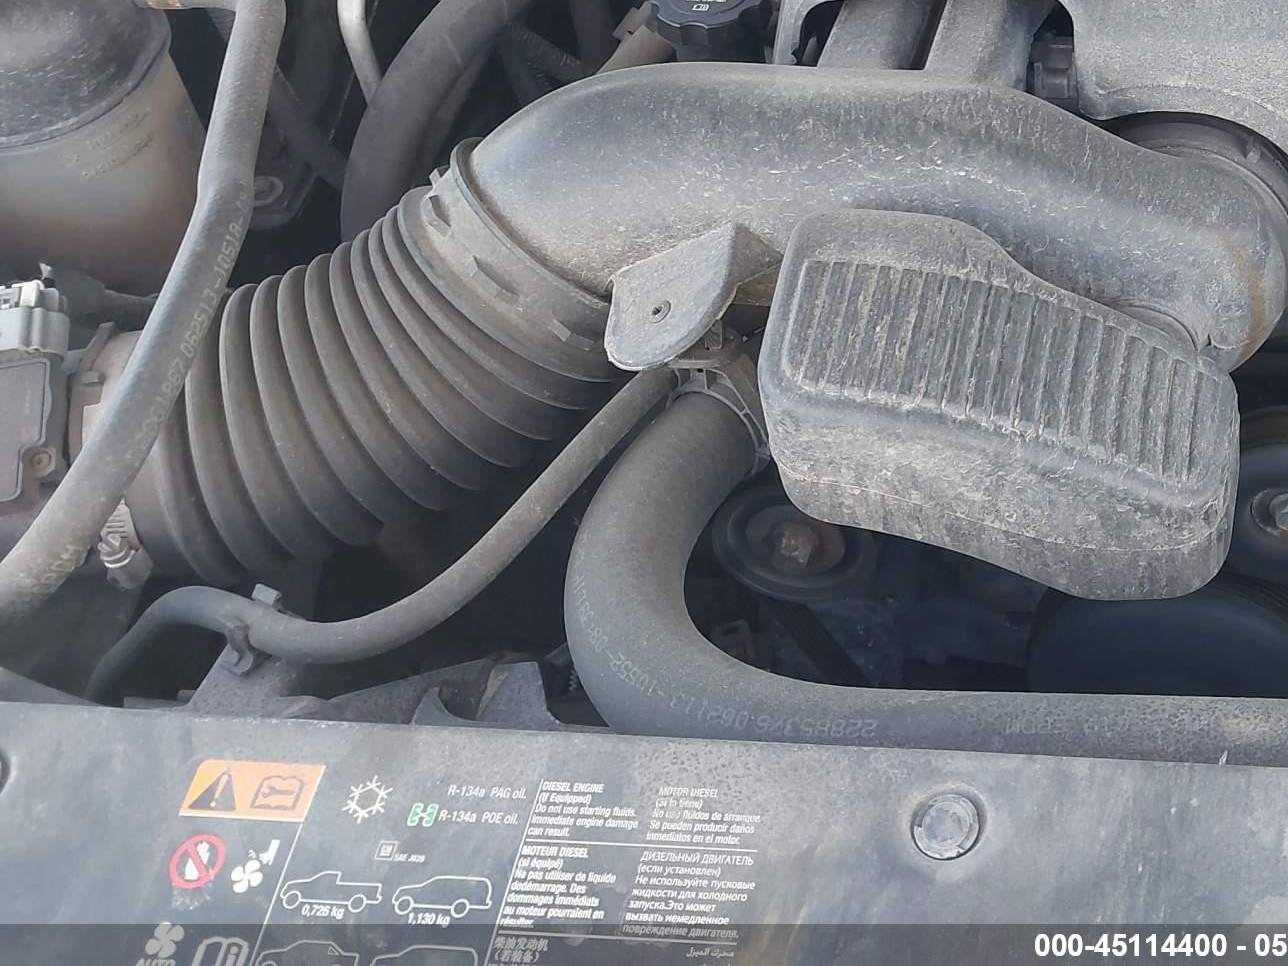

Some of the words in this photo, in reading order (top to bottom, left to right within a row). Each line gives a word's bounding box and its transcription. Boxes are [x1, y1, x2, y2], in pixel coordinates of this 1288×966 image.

[447, 784, 485, 797] R-134a
[490, 786, 511, 798] PAG
[512, 787, 527, 799] oil.
[541, 781, 571, 792] DIESEL
[573, 783, 605, 793] ENGINE
[658, 786, 689, 797] MOTOR
[690, 788, 719, 798] DIESEL
[550, 793, 592, 804] Equipped)
[438, 809, 476, 823] R-134a
[481, 811, 503, 824] POE
[504, 813, 518, 825] oil.
[535, 804, 546, 813] Do
[548, 804, 562, 814] not
[563, 806, 578, 814] use
[579, 806, 610, 817] starting
[612, 806, 637, 817] fluids.
[682, 810, 710, 821] fluidos
[711, 811, 721, 821] de
[531, 814, 575, 826] Immediate
[576, 817, 603, 828] engine
[605, 817, 639, 830] damage
[649, 820, 659, 829] Se
[661, 820, 693, 831] pueden
[693, 823, 729, 833] producir
[527, 827, 544, 836] can
[544, 827, 570, 837] result.
[692, 835, 704, 843] en
[705, 834, 714, 844] el
[521, 845, 558, 856] MOTEUR
[559, 847, 589, 858] DIESEL
[640, 851, 700, 863] ДИЗЕЛЬНЫЙ
[701, 854, 754, 865] ДВИГАТЕЛЬ
[531, 857, 563, 869] équipé)
[514, 869, 526, 879] Ne
[527, 871, 543, 881] pas
[544, 871, 574, 881] utiliser
[575, 872, 586, 881] de
[588, 872, 616, 883] liquide
[638, 863, 662, 874] (если
[664, 865, 721, 877] установлен)
[569, 884, 586, 893] Des
[635, 875, 649, 884] Не
[650, 876, 709, 888] используйте
[710, 879, 756, 890] пусковые
[507, 892, 553, 906] dommages
[554, 895, 599, 906] immédiats
[632, 888, 677, 898] жидкости
[678, 890, 696, 900] для
[698, 891, 748, 902] холодного
[301, 906, 328, 918] 0,726
[329, 907, 344, 919] kg
[503, 906, 515, 914] au
[516, 905, 547, 916] moteur
[547, 907, 592, 919] pourraient
[592, 910, 604, 919] en
[685, 903, 717, 912] может
[407, 912, 435, 925] 1,130
[436, 914, 450, 928] kg
[626, 912, 663, 923] вызвать
[665, 914, 729, 926] немедленное
[622, 924, 687, 936] повреждение
[688, 927, 739, 938] двигателя.
